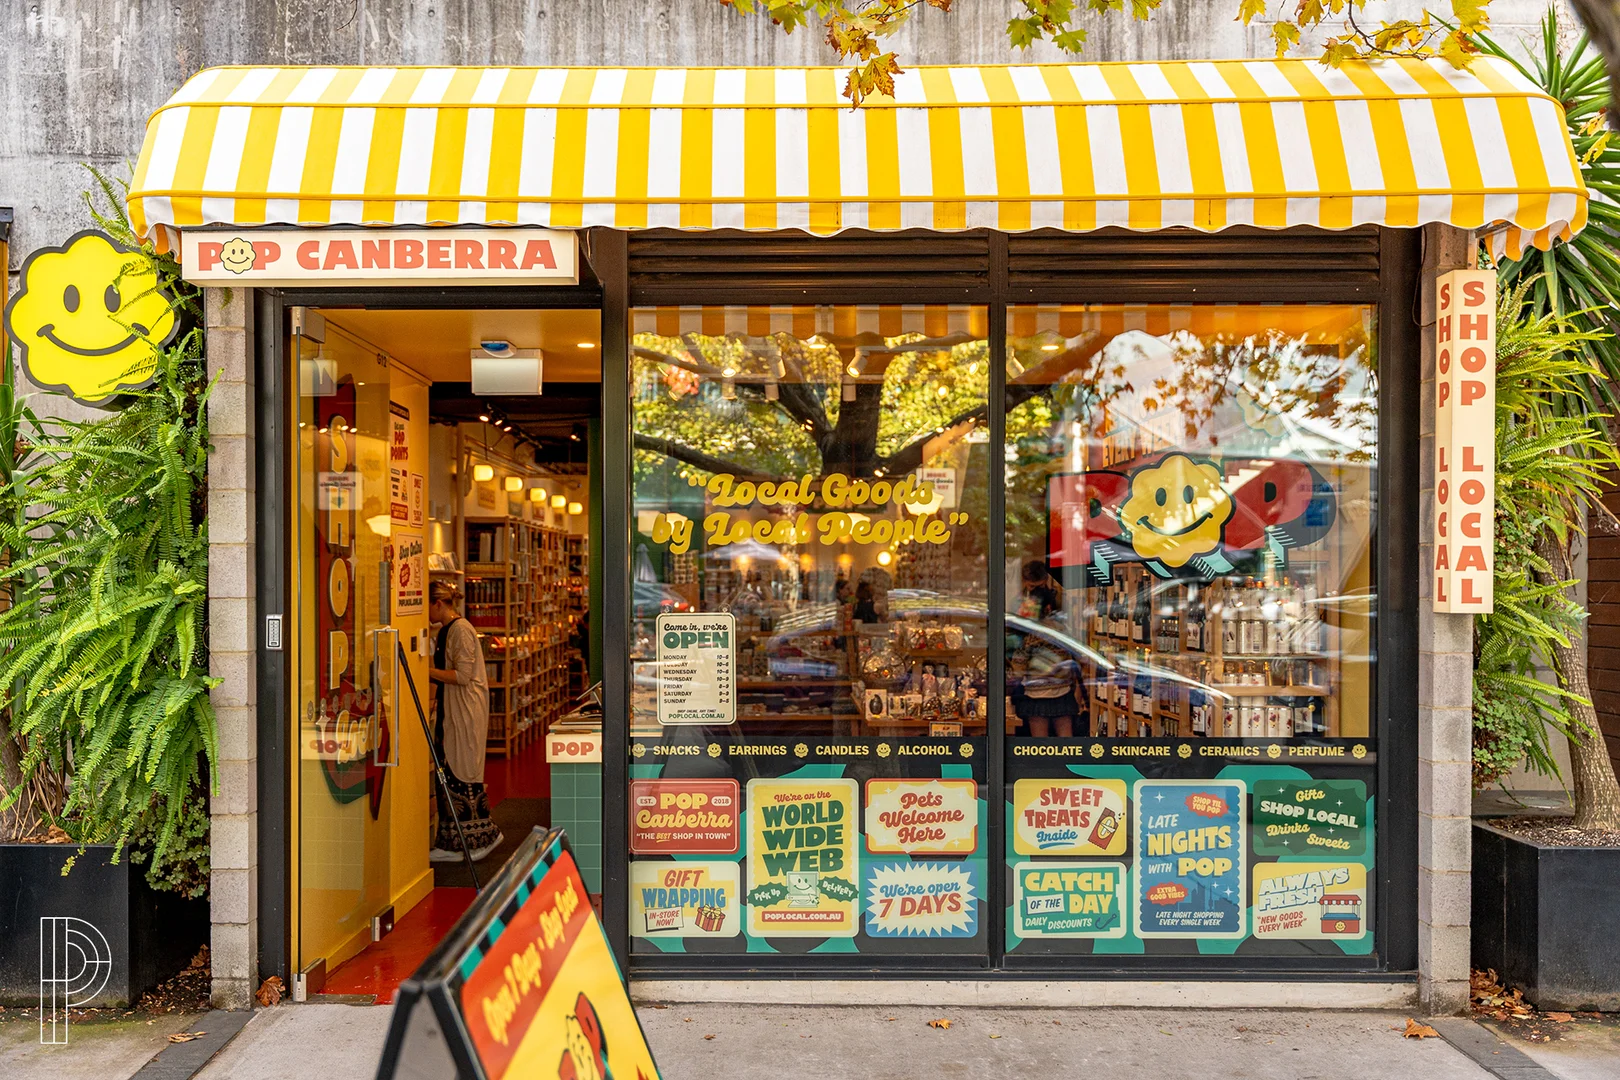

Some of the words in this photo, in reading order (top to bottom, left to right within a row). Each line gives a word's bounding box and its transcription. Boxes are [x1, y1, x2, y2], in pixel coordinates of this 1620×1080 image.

[297, 240, 557, 270] CANBERRA
[1439, 283, 1451, 408] SHOP
[1460, 281, 1488, 406] SHOP
[377, 353, 387, 367] G12
[822, 473, 935, 506] Goods
[652, 512, 694, 554] by
[703, 512, 811, 545] Local
[1436, 447, 1449, 602] LOCAL
[1455, 447, 1488, 604] LOCAL
[664, 623, 688, 631] Come
[689, 623, 700, 631] in,
[703, 623, 728, 631] we're
[663, 632, 729, 649] OPEN
[552, 742, 594, 756] POP
[653, 745, 700, 756] SNACKS
[729, 745, 787, 756] EARRINGS
[816, 745, 869, 756] CANDLES
[898, 745, 952, 756] ALCOHOL
[1013, 745, 1083, 756] CHOCOLATE
[1111, 745, 1170, 756] SKINCARE
[1199, 745, 1259, 756] CERAMICS
[1289, 745, 1345, 756] PERFUME
[660, 793, 708, 809] POP
[774, 793, 803, 802] We're
[817, 791, 832, 799] the
[901, 792, 943, 809] Pets
[1040, 787, 1103, 807] SWEET
[1193, 796, 1211, 804] SHOP
[1213, 800, 1222, 808] TIL
[1296, 789, 1326, 802] Gifts
[762, 800, 844, 827] WORLD
[1192, 802, 1206, 811] YOU
[1207, 806, 1221, 814] POP
[1260, 800, 1305, 818] SHOP
[1307, 809, 1358, 828] LOCAL
[636, 809, 733, 828] Canberra
[879, 810, 964, 828] Welcome
[1025, 809, 1090, 828] TREATS
[1148, 814, 1179, 829] LATE
[762, 824, 843, 850] WIDE
[898, 826, 946, 844] Here
[1036, 829, 1078, 842] Inside
[1266, 823, 1310, 836] Drinks
[1148, 826, 1232, 856] NIGHTS
[1306, 833, 1351, 849] Sweets
[762, 848, 843, 877] WEB
[1148, 863, 1172, 874] WITH
[1178, 858, 1232, 876] POP
[664, 870, 704, 887] GIFT
[1025, 872, 1114, 892] CATCH
[1259, 867, 1350, 896] ALWAYS
[754, 892, 771, 901] PICK
[771, 889, 781, 897] UP
[822, 881, 853, 897] DELIVERY
[880, 884, 925, 897] We're
[928, 882, 961, 896] open
[1150, 893, 1167, 901] GOOD
[1168, 891, 1185, 899] VIBES
[1157, 886, 1176, 894] EXTRA
[642, 888, 726, 908] WRAPPING
[880, 898, 894, 918] 7
[900, 893, 962, 916] DAYS
[1030, 900, 1041, 909] OF
[1045, 898, 1061, 908] THE
[1069, 894, 1113, 914] DAY
[1258, 887, 1324, 911] FRESH
[649, 910, 680, 919] IN-STORE
[656, 918, 674, 926] NOW!
[1279, 911, 1304, 921] GOODS
[1025, 917, 1047, 926] DAILY
[1048, 918, 1092, 930] DISCOUNTS
[1258, 923, 1281, 933] EVERY
